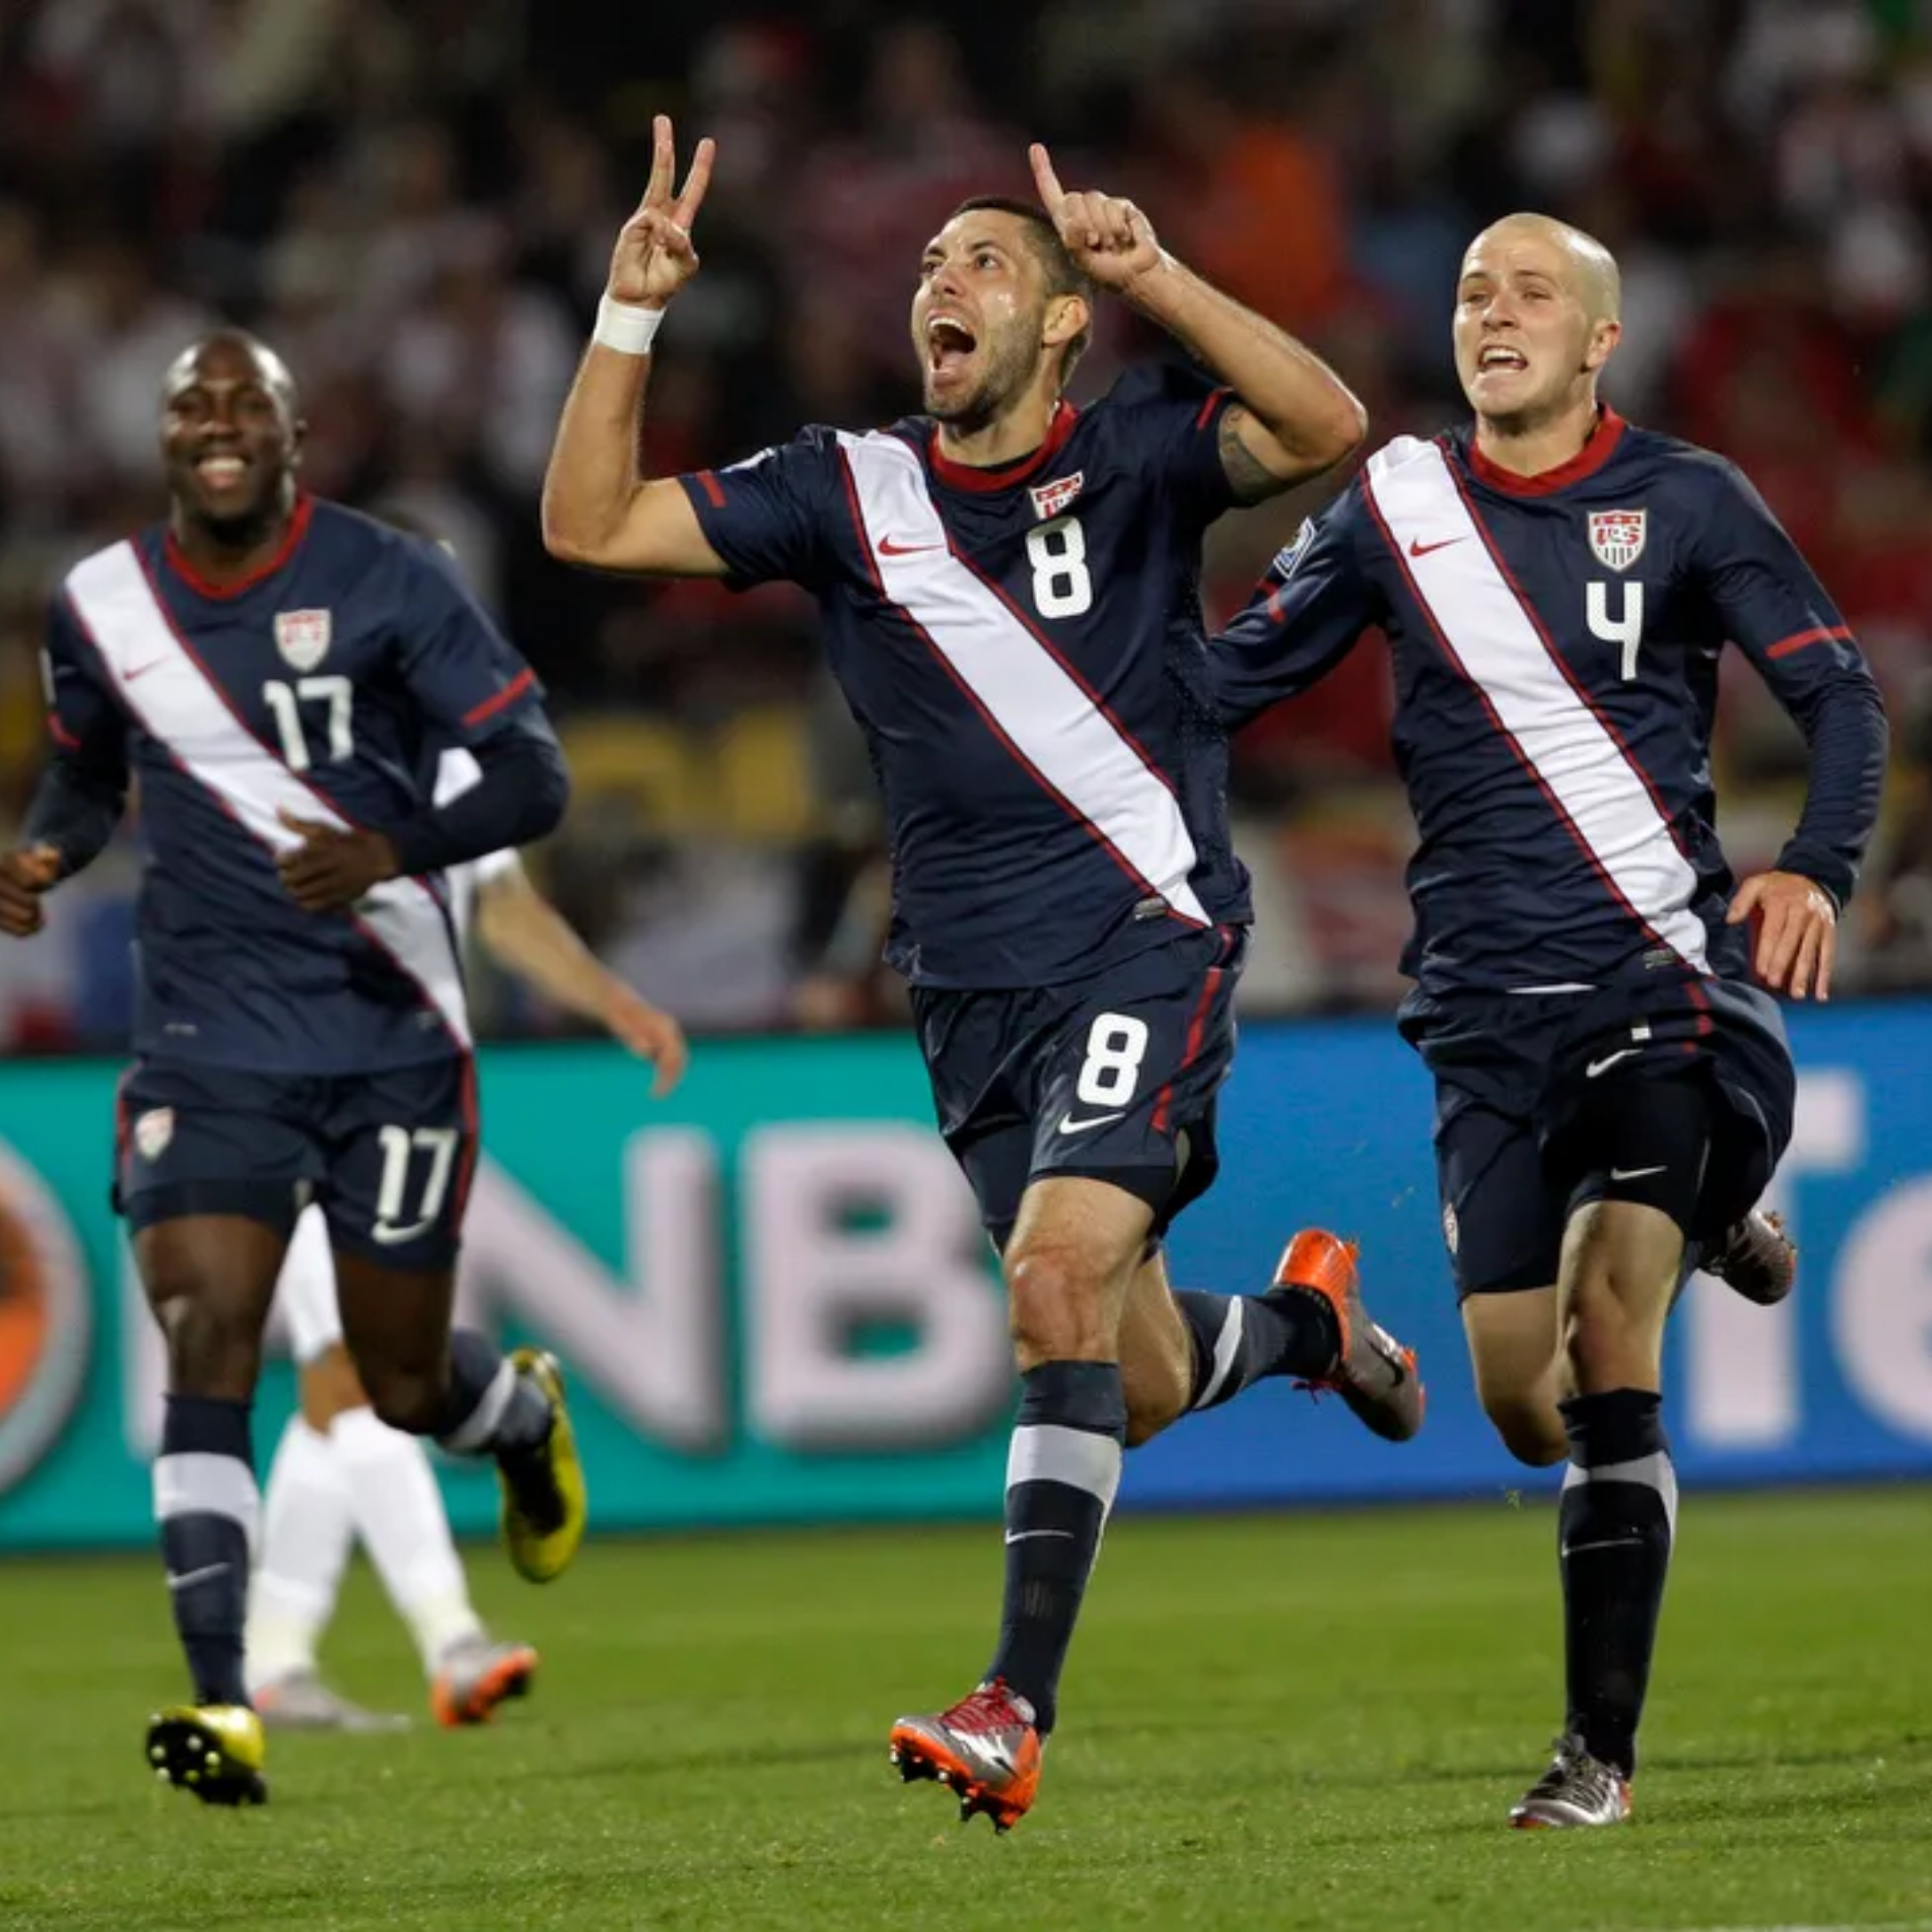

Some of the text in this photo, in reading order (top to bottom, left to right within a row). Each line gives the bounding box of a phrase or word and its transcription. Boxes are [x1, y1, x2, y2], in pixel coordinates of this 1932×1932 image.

[1025, 515, 1092, 619] 8
[1586, 582, 1643, 681] 4
[263, 675, 354, 772] 17
[1077, 1011, 1148, 1106] 8
[377, 1124, 459, 1220] 17
